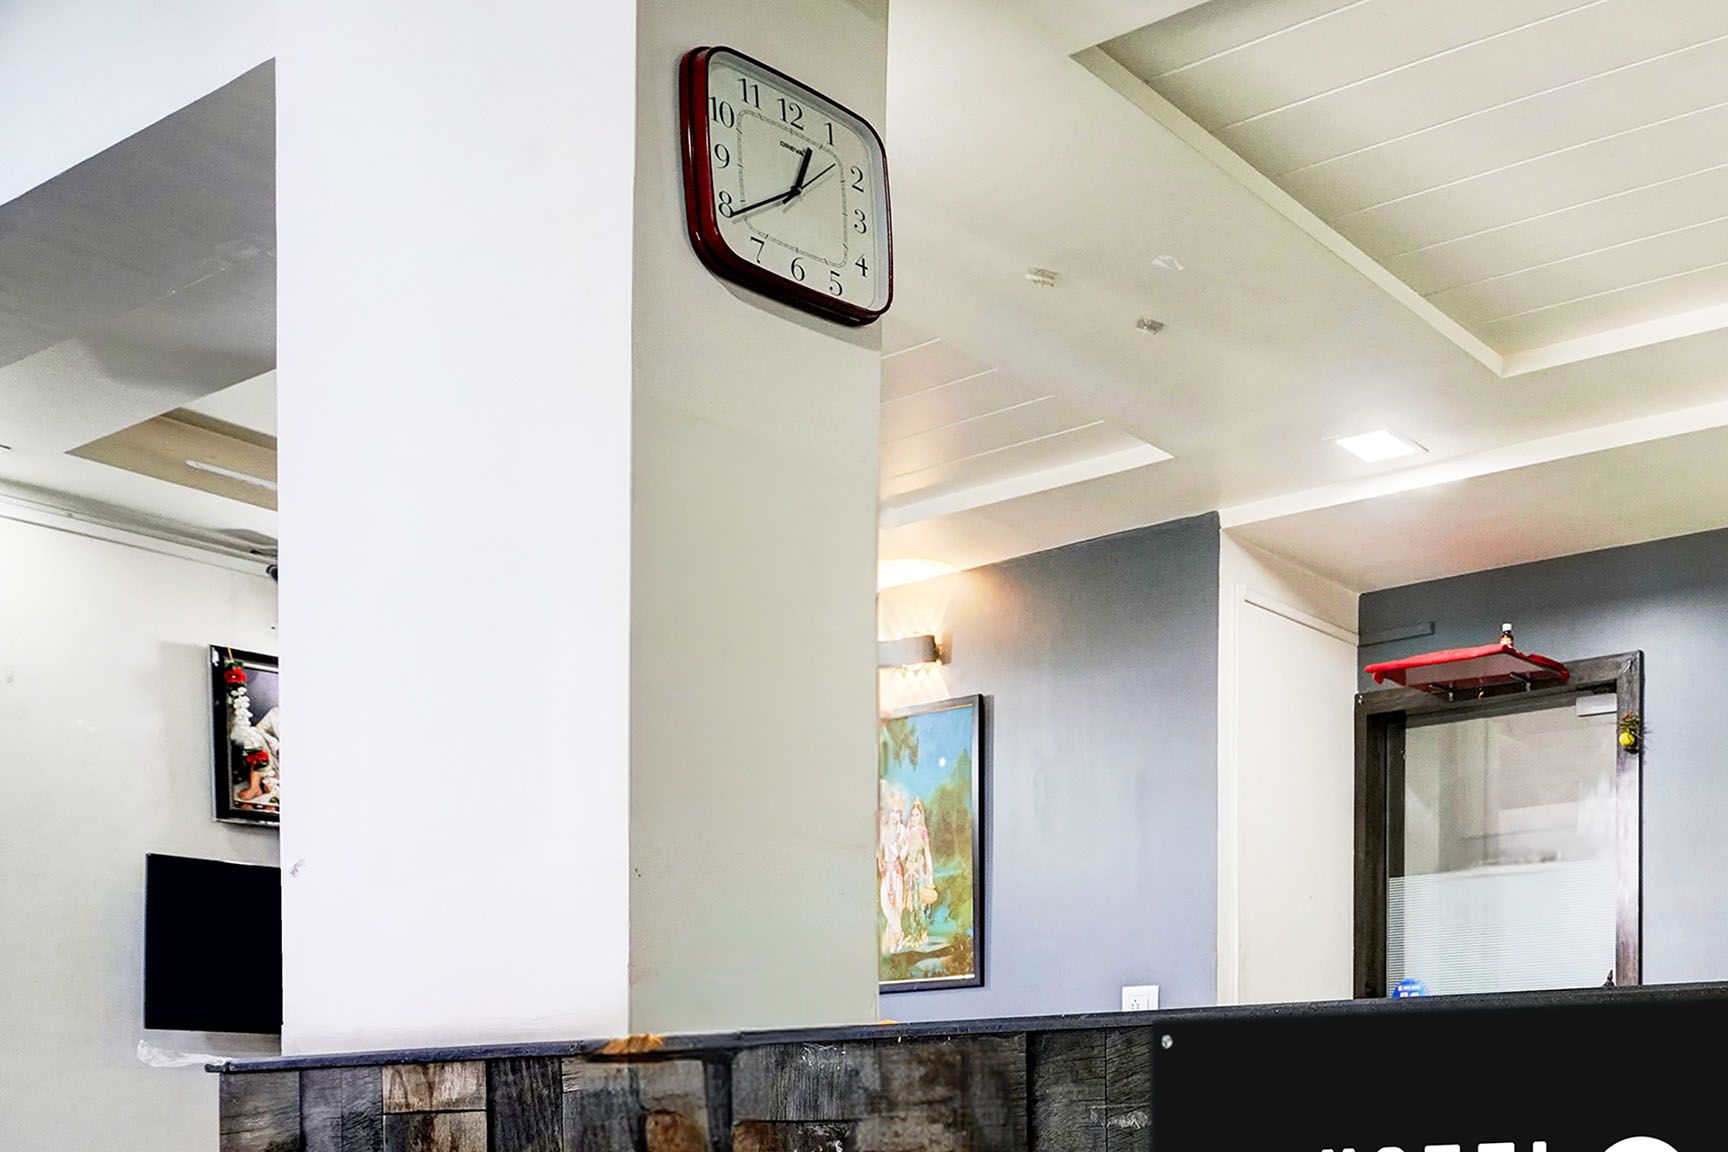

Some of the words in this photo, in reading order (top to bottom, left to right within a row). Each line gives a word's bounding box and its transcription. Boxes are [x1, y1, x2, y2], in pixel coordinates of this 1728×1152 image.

[737, 78, 762, 110] 11
[709, 96, 735, 129] 10
[776, 98, 804, 131] 12
[823, 122, 835, 147] 1
[714, 143, 730, 169] 9
[849, 165, 865, 193] 2
[718, 190, 733, 218] 8
[853, 209, 867, 235] 3
[749, 236, 765, 264] 7
[790, 257, 805, 281] 6
[854, 255, 868, 278] 4
[828, 270, 842, 296] 5
